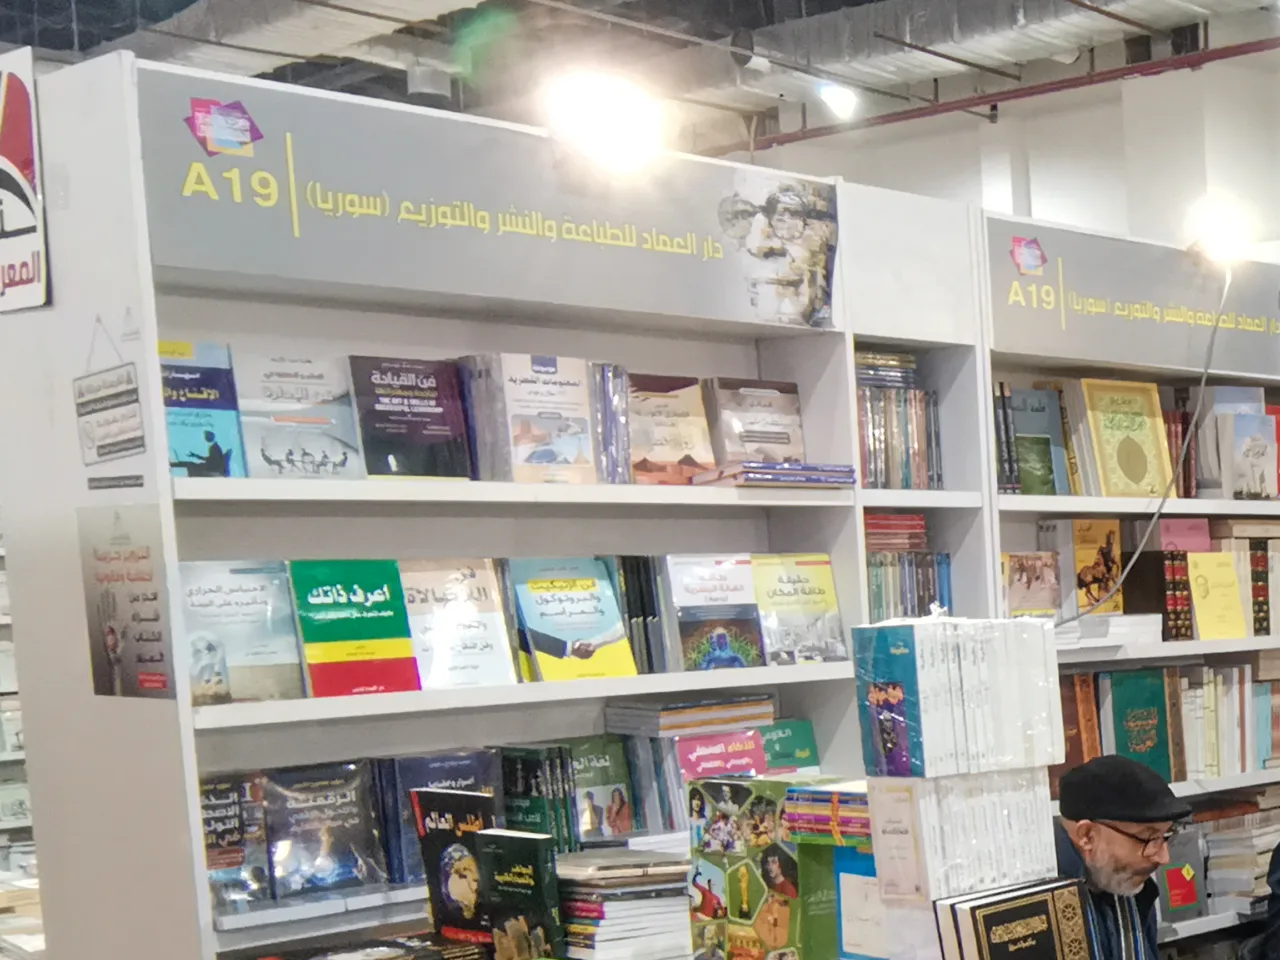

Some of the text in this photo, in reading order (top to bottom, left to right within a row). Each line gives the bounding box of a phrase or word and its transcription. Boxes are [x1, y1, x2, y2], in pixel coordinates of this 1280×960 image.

[181, 161, 279, 208] A19
[306, 180, 724, 261] دار العماد للطباعة والنشر والتوزيع (سوريا)
[1008, 281, 1055, 310] A19
[307, 587, 347, 605] ذاتك
[349, 584, 391, 607] اعرف
